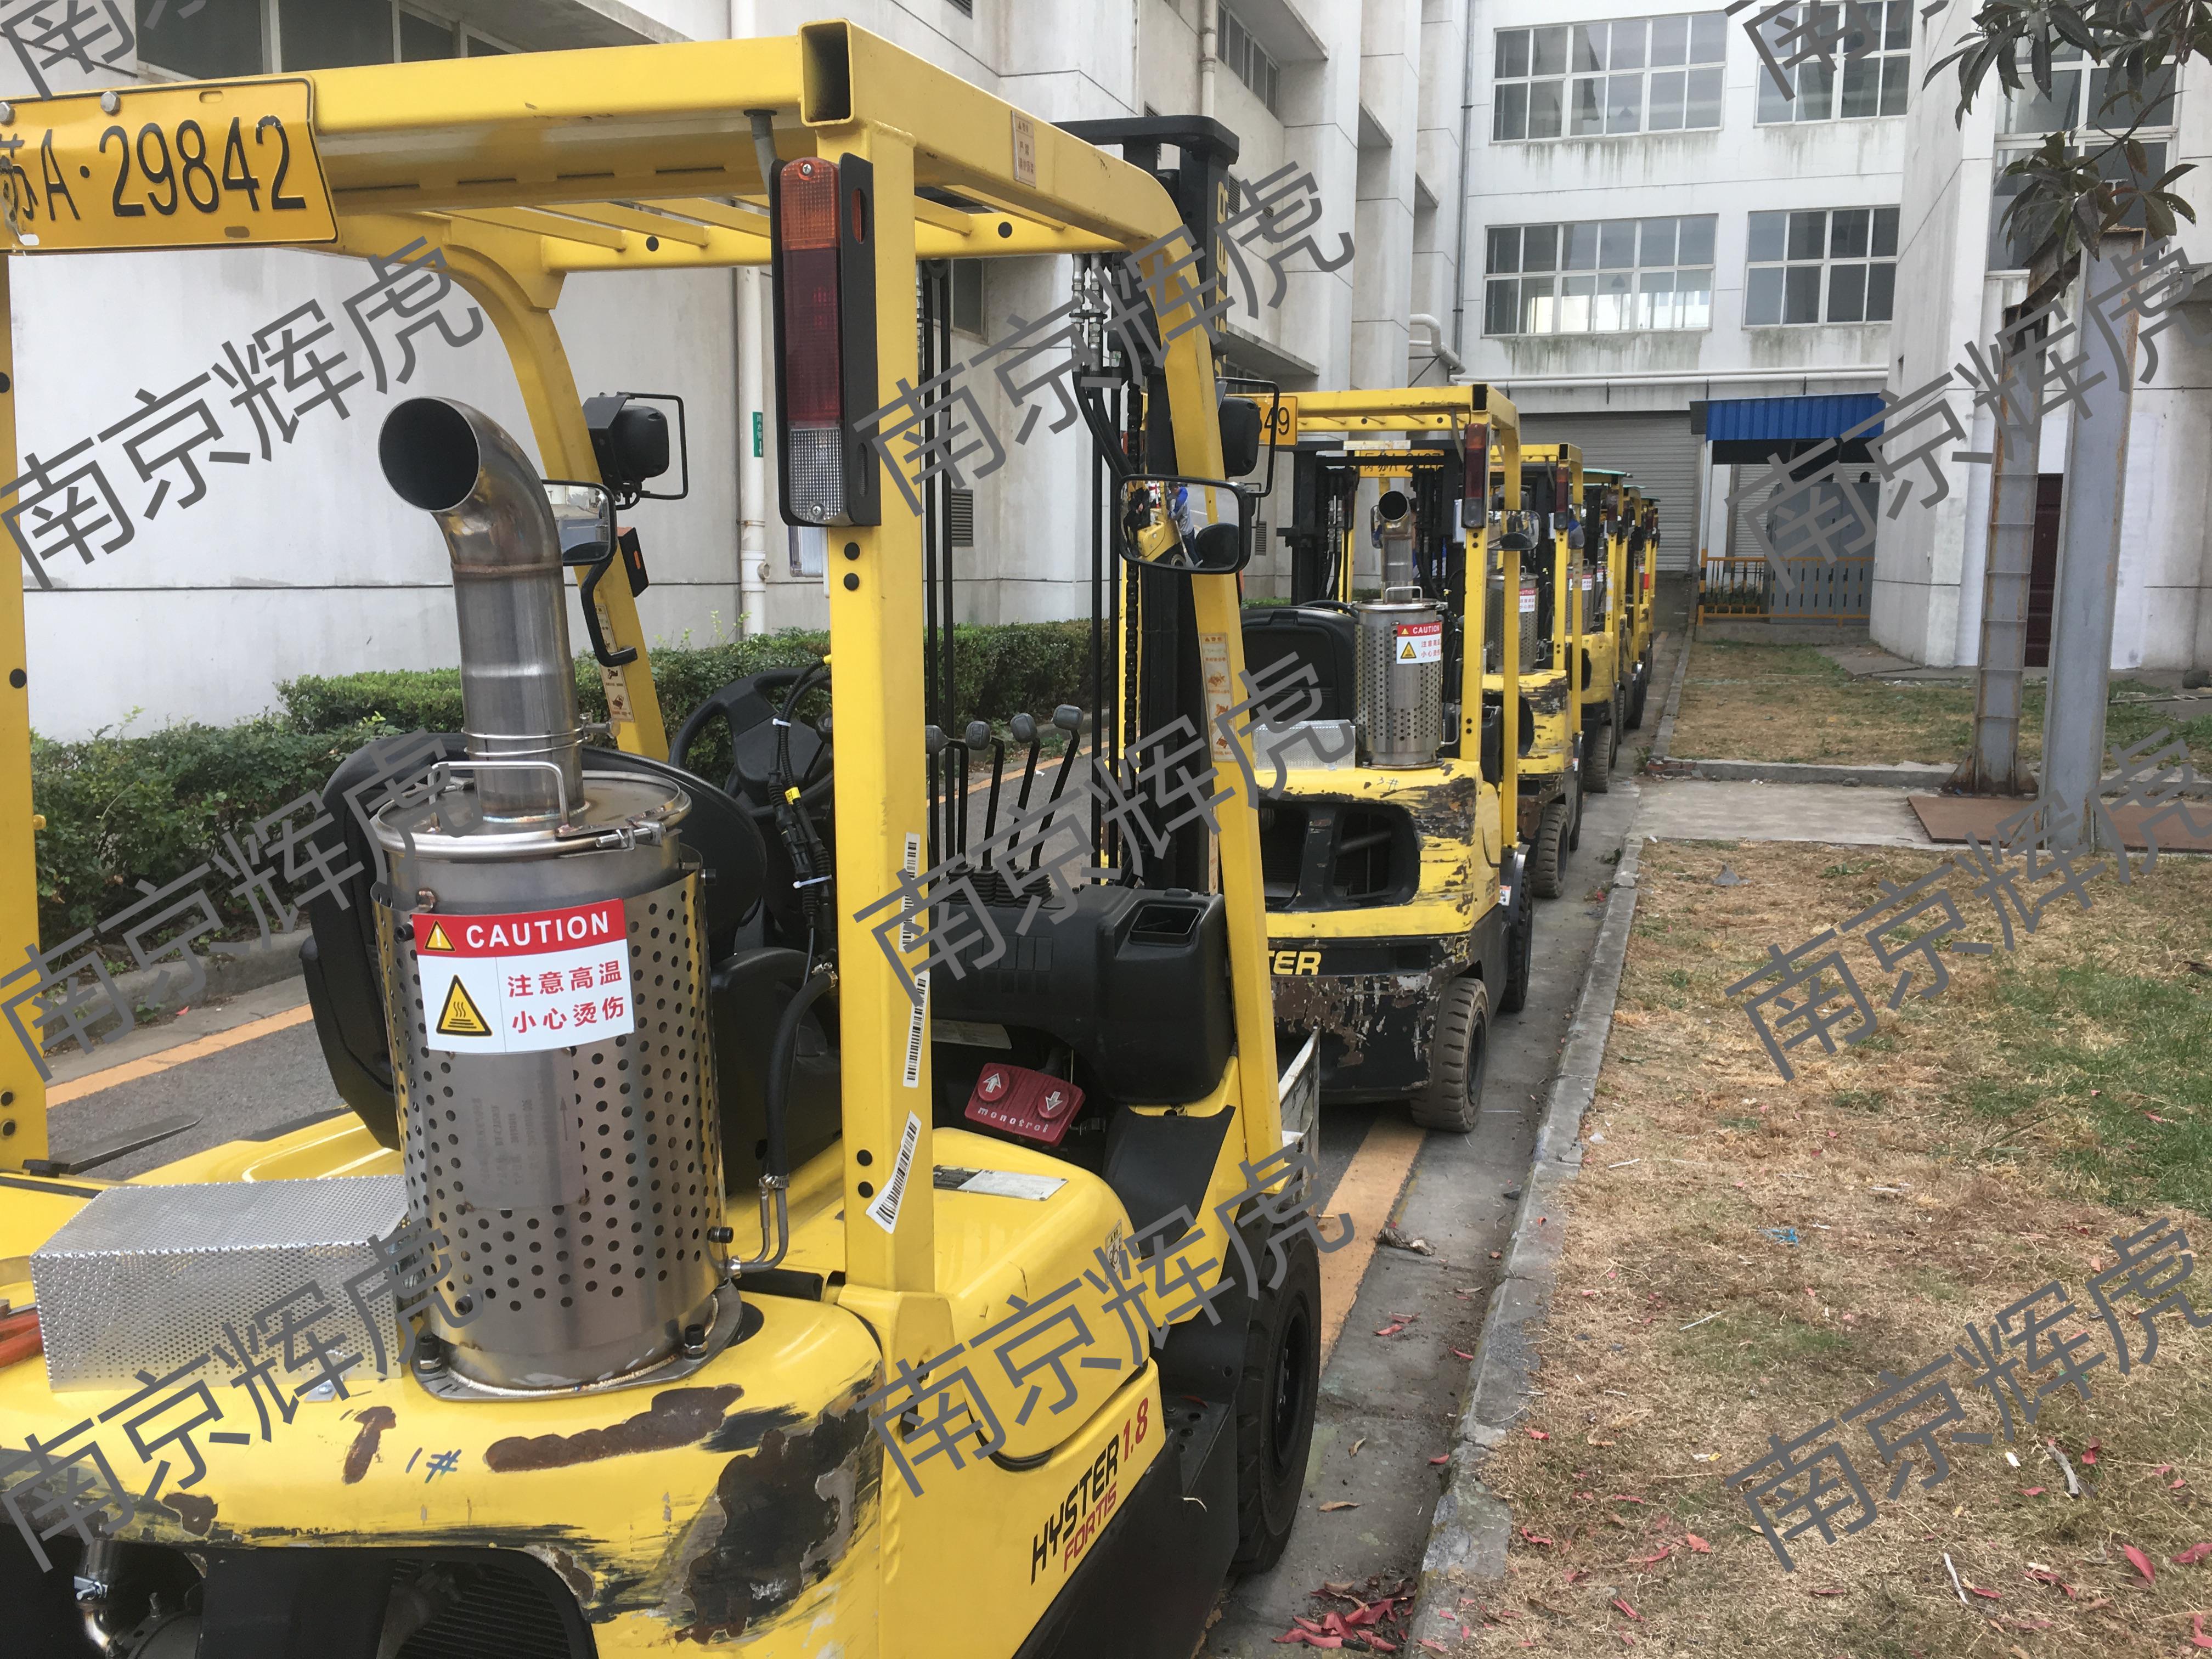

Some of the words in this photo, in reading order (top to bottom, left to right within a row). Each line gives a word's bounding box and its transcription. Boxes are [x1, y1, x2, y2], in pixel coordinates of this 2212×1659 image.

[1259, 407, 1290, 436] 49
[466, 911, 608, 949] CAUTION
[508, 960, 622, 997] 注意高温
[512, 996, 624, 1034] 小心烫伤
[978, 1107, 1049, 1133] monotrol
[405, 1447, 462, 1484] 1#
[1031, 1434, 1119, 1586] HYSTER
[1123, 1397, 1148, 1463] 1.8
[1063, 1480, 1117, 1573] FORTIS
